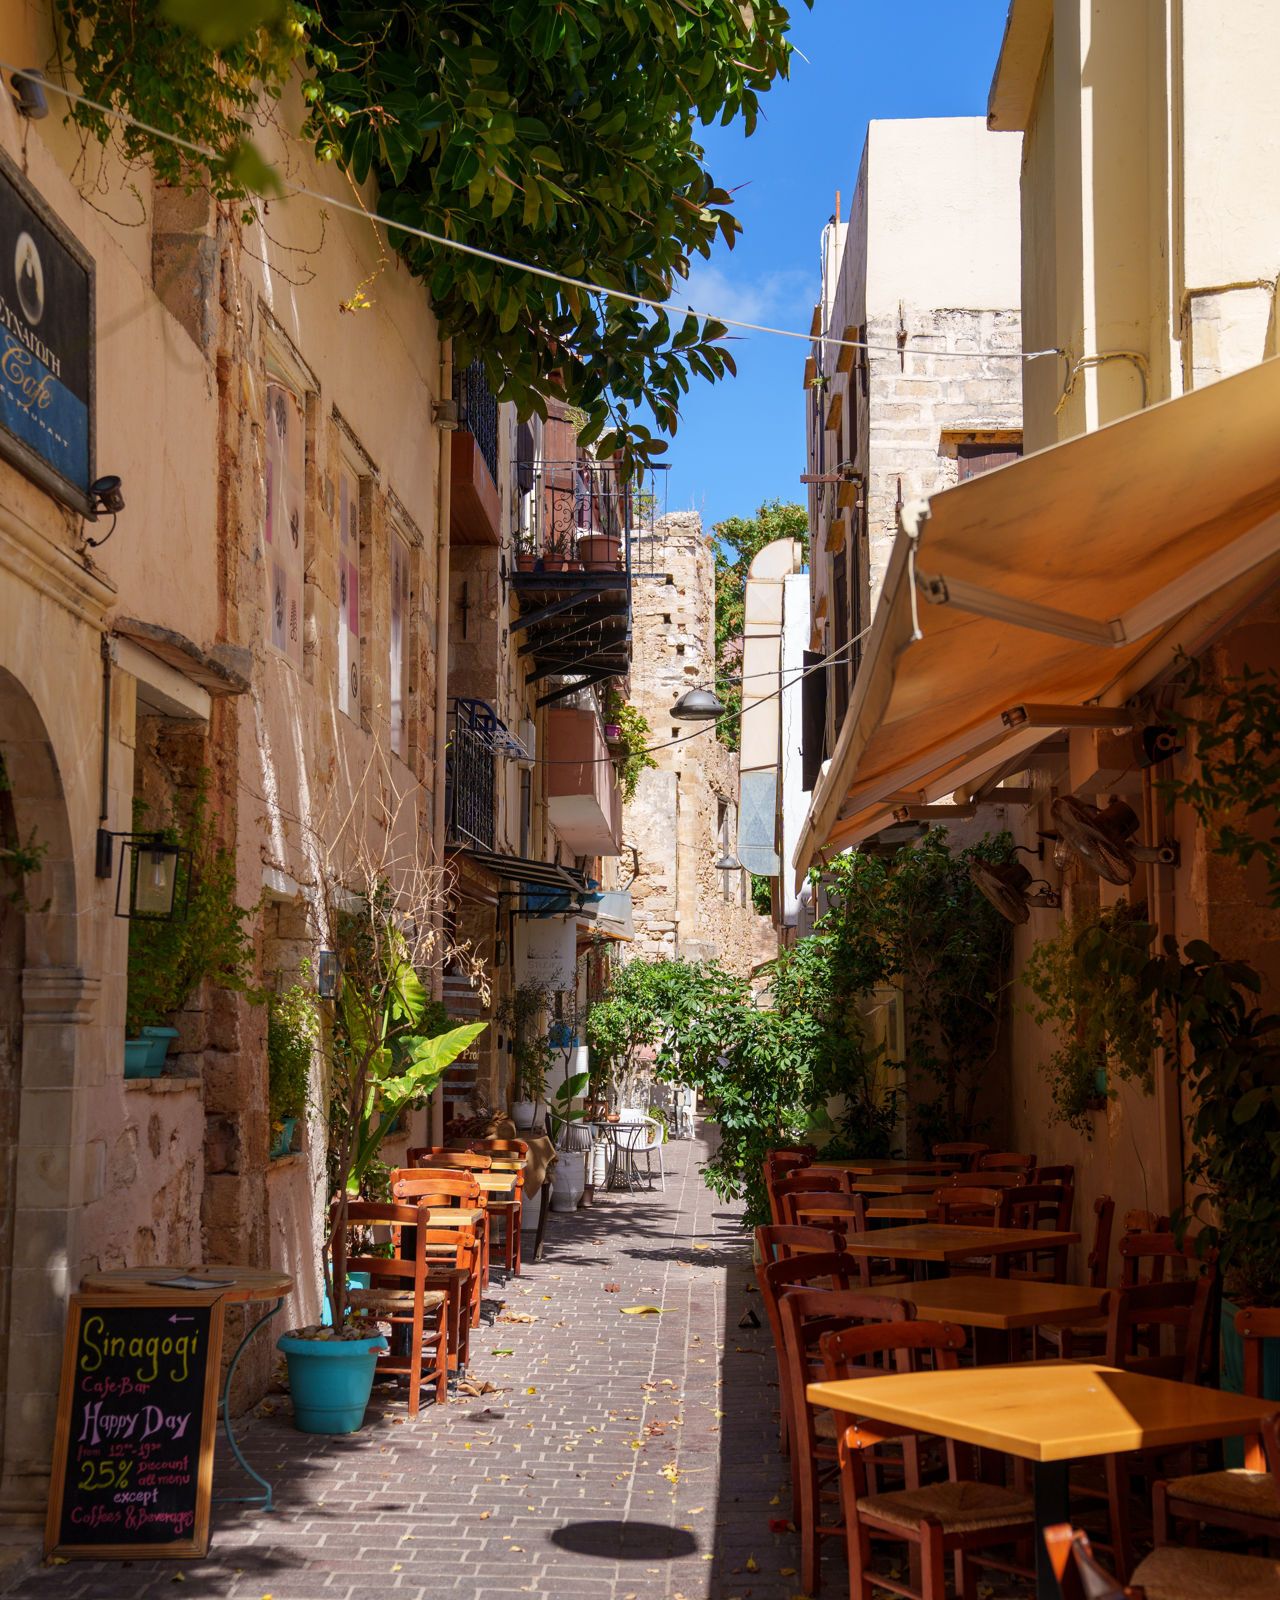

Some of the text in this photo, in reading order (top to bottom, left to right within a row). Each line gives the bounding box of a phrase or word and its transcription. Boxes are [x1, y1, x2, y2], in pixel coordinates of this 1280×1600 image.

[2, 335, 56, 409] Cafe
[80, 1316, 199, 1382] Sinagogi
[81, 1375, 150, 1398] Cafe-Bar
[78, 1401, 192, 1446] Happy Day
[78, 1460, 133, 1491] 25%
[137, 1474, 190, 1486] all menu
[113, 1488, 158, 1506] except
[71, 1505, 194, 1533] Coffees & Beverages
